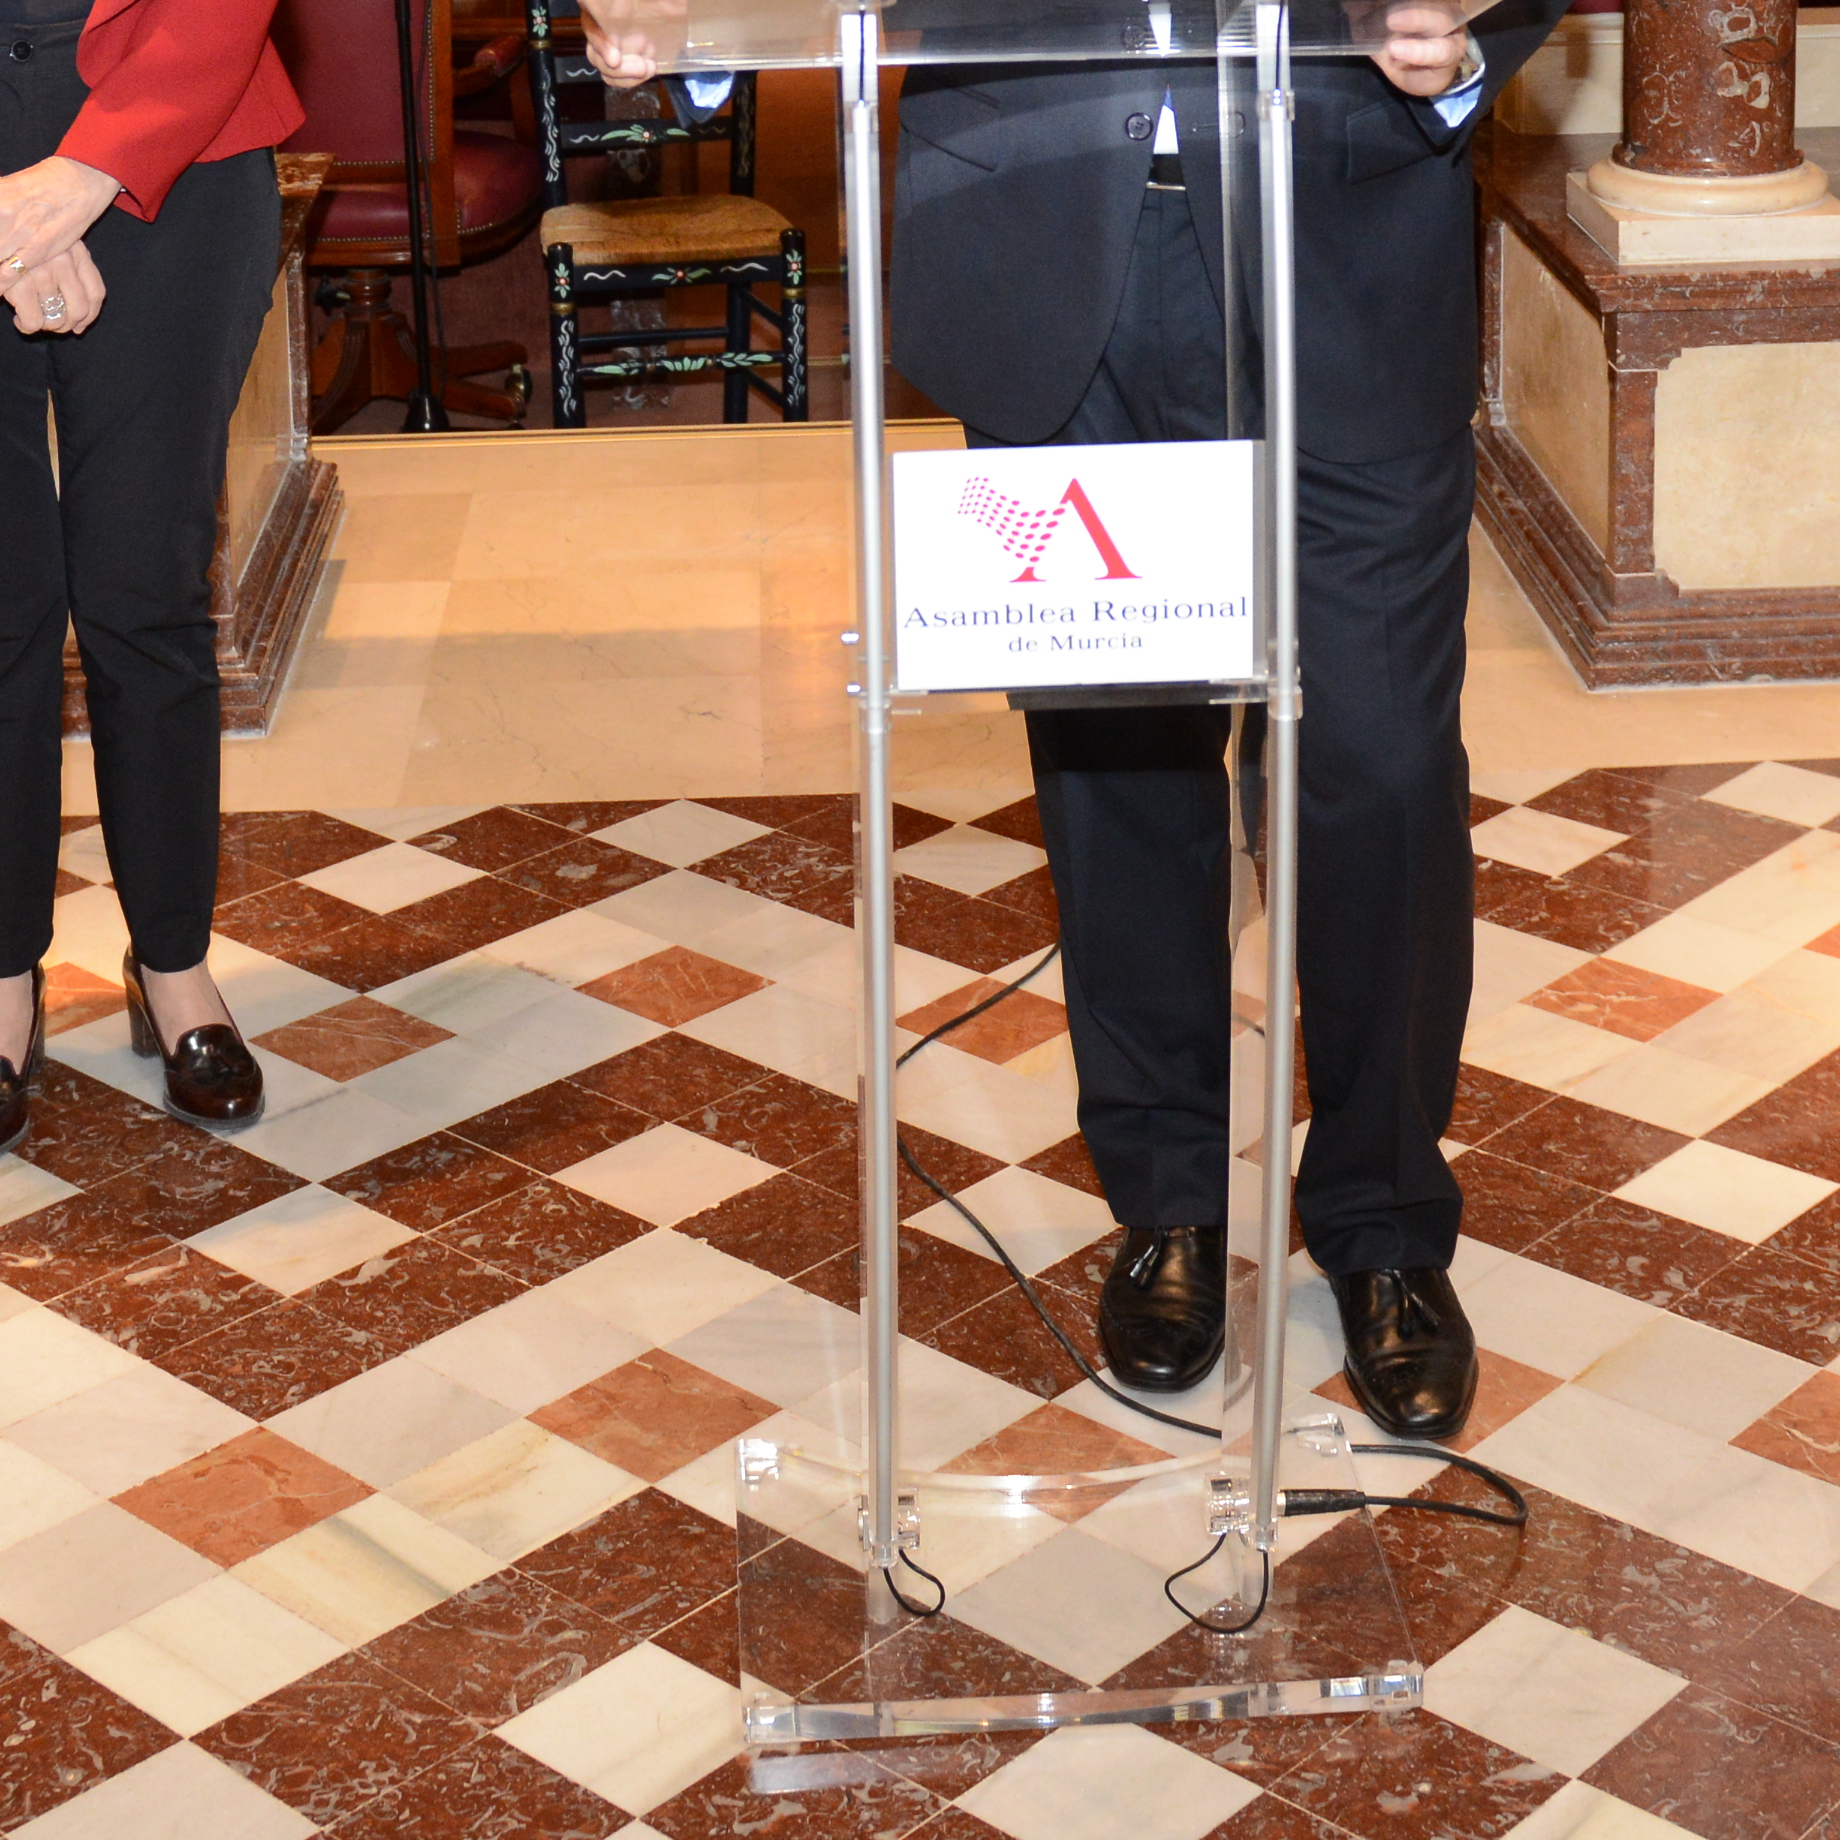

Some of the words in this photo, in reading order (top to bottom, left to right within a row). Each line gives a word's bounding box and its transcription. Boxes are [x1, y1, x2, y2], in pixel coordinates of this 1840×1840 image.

[904, 603, 1076, 629] Asamblea
[1092, 596, 1248, 624] Regional
[1008, 635, 1038, 653] de
[1050, 632, 1143, 652] Murcia
